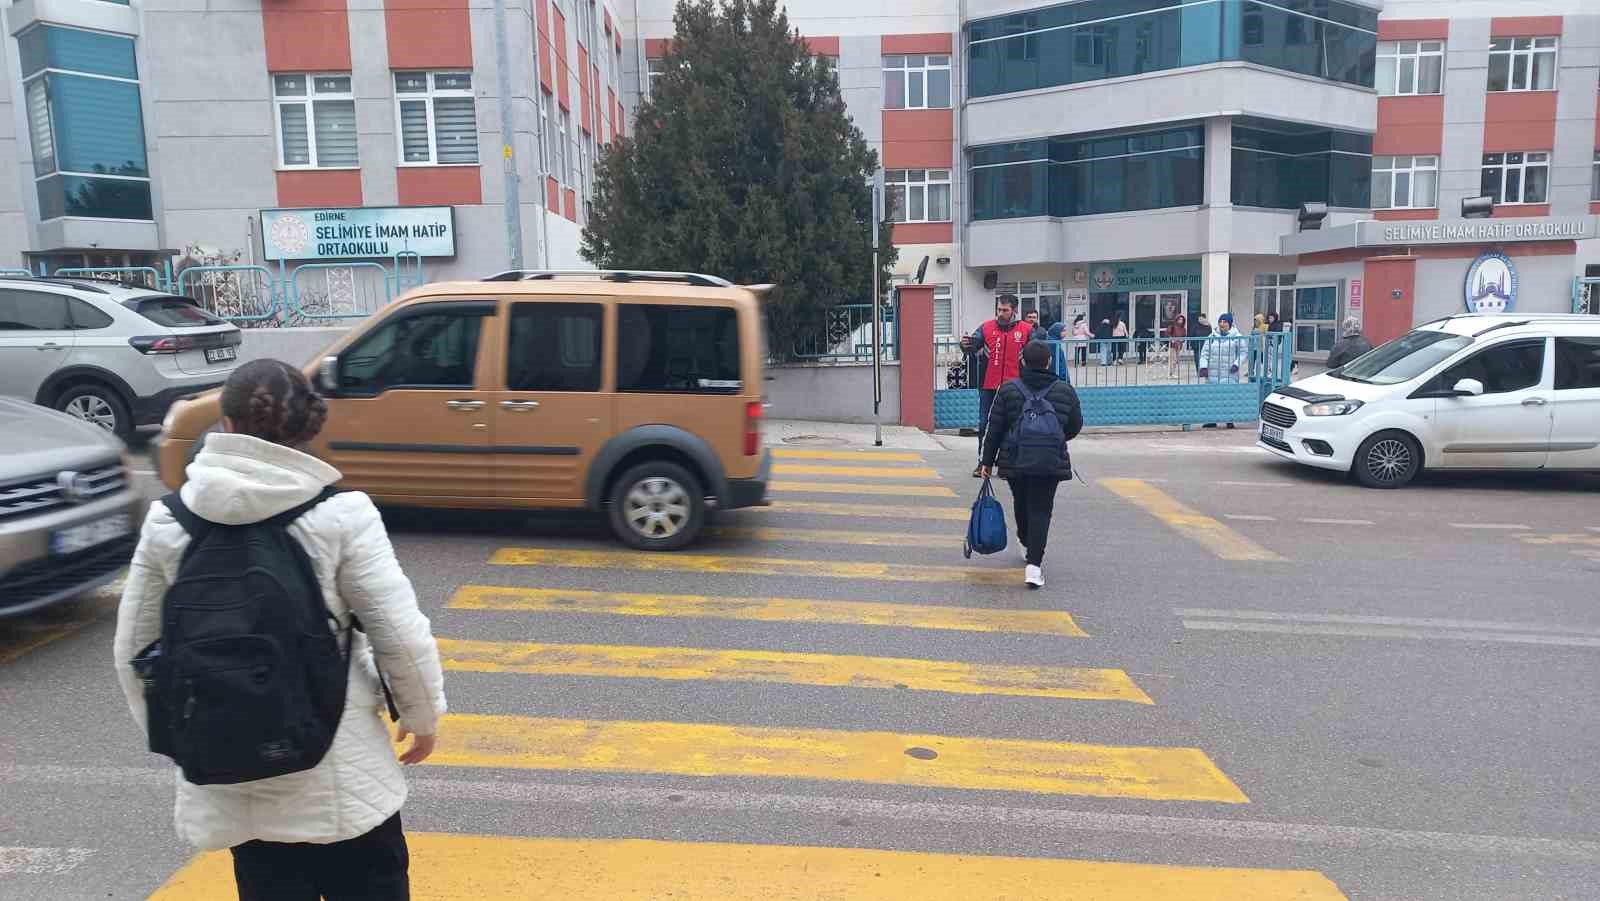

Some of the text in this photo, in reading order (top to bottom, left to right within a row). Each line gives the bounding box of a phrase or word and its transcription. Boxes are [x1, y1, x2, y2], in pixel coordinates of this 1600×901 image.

[314, 211, 346, 222] EDİRNE
[316, 221, 447, 240] SELİMİYE İMAM HATİP
[1515, 221, 1585, 238] ORTAOKULU
[317, 241, 389, 256] ORTAOKULU
